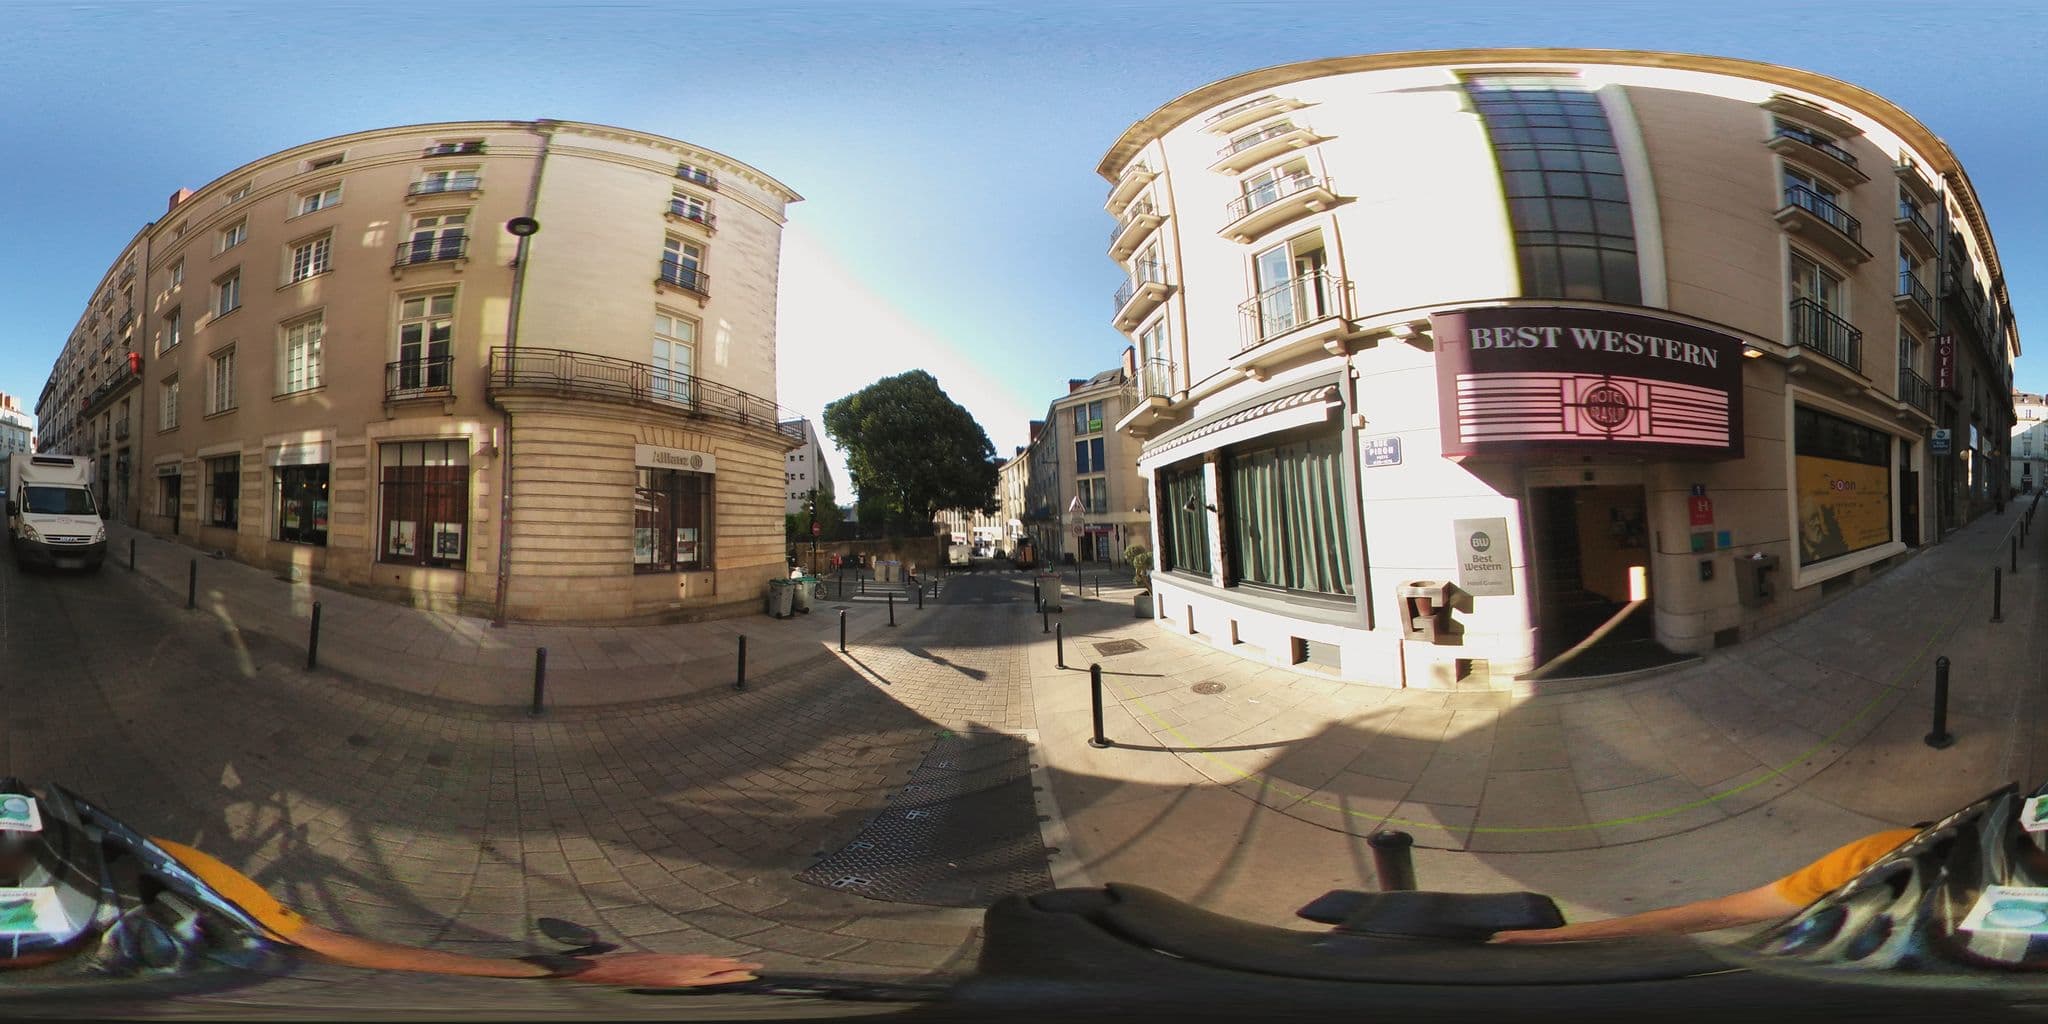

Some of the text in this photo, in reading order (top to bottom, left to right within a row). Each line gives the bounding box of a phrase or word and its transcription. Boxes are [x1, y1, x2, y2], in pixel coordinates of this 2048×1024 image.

[1469, 326, 1719, 369] BEST WESTERN
[1939, 335, 1951, 389] HOTEL
[1472, 537, 1489, 547] BW
[1472, 554, 1493, 563] Best
[1464, 562, 1502, 571] Western
